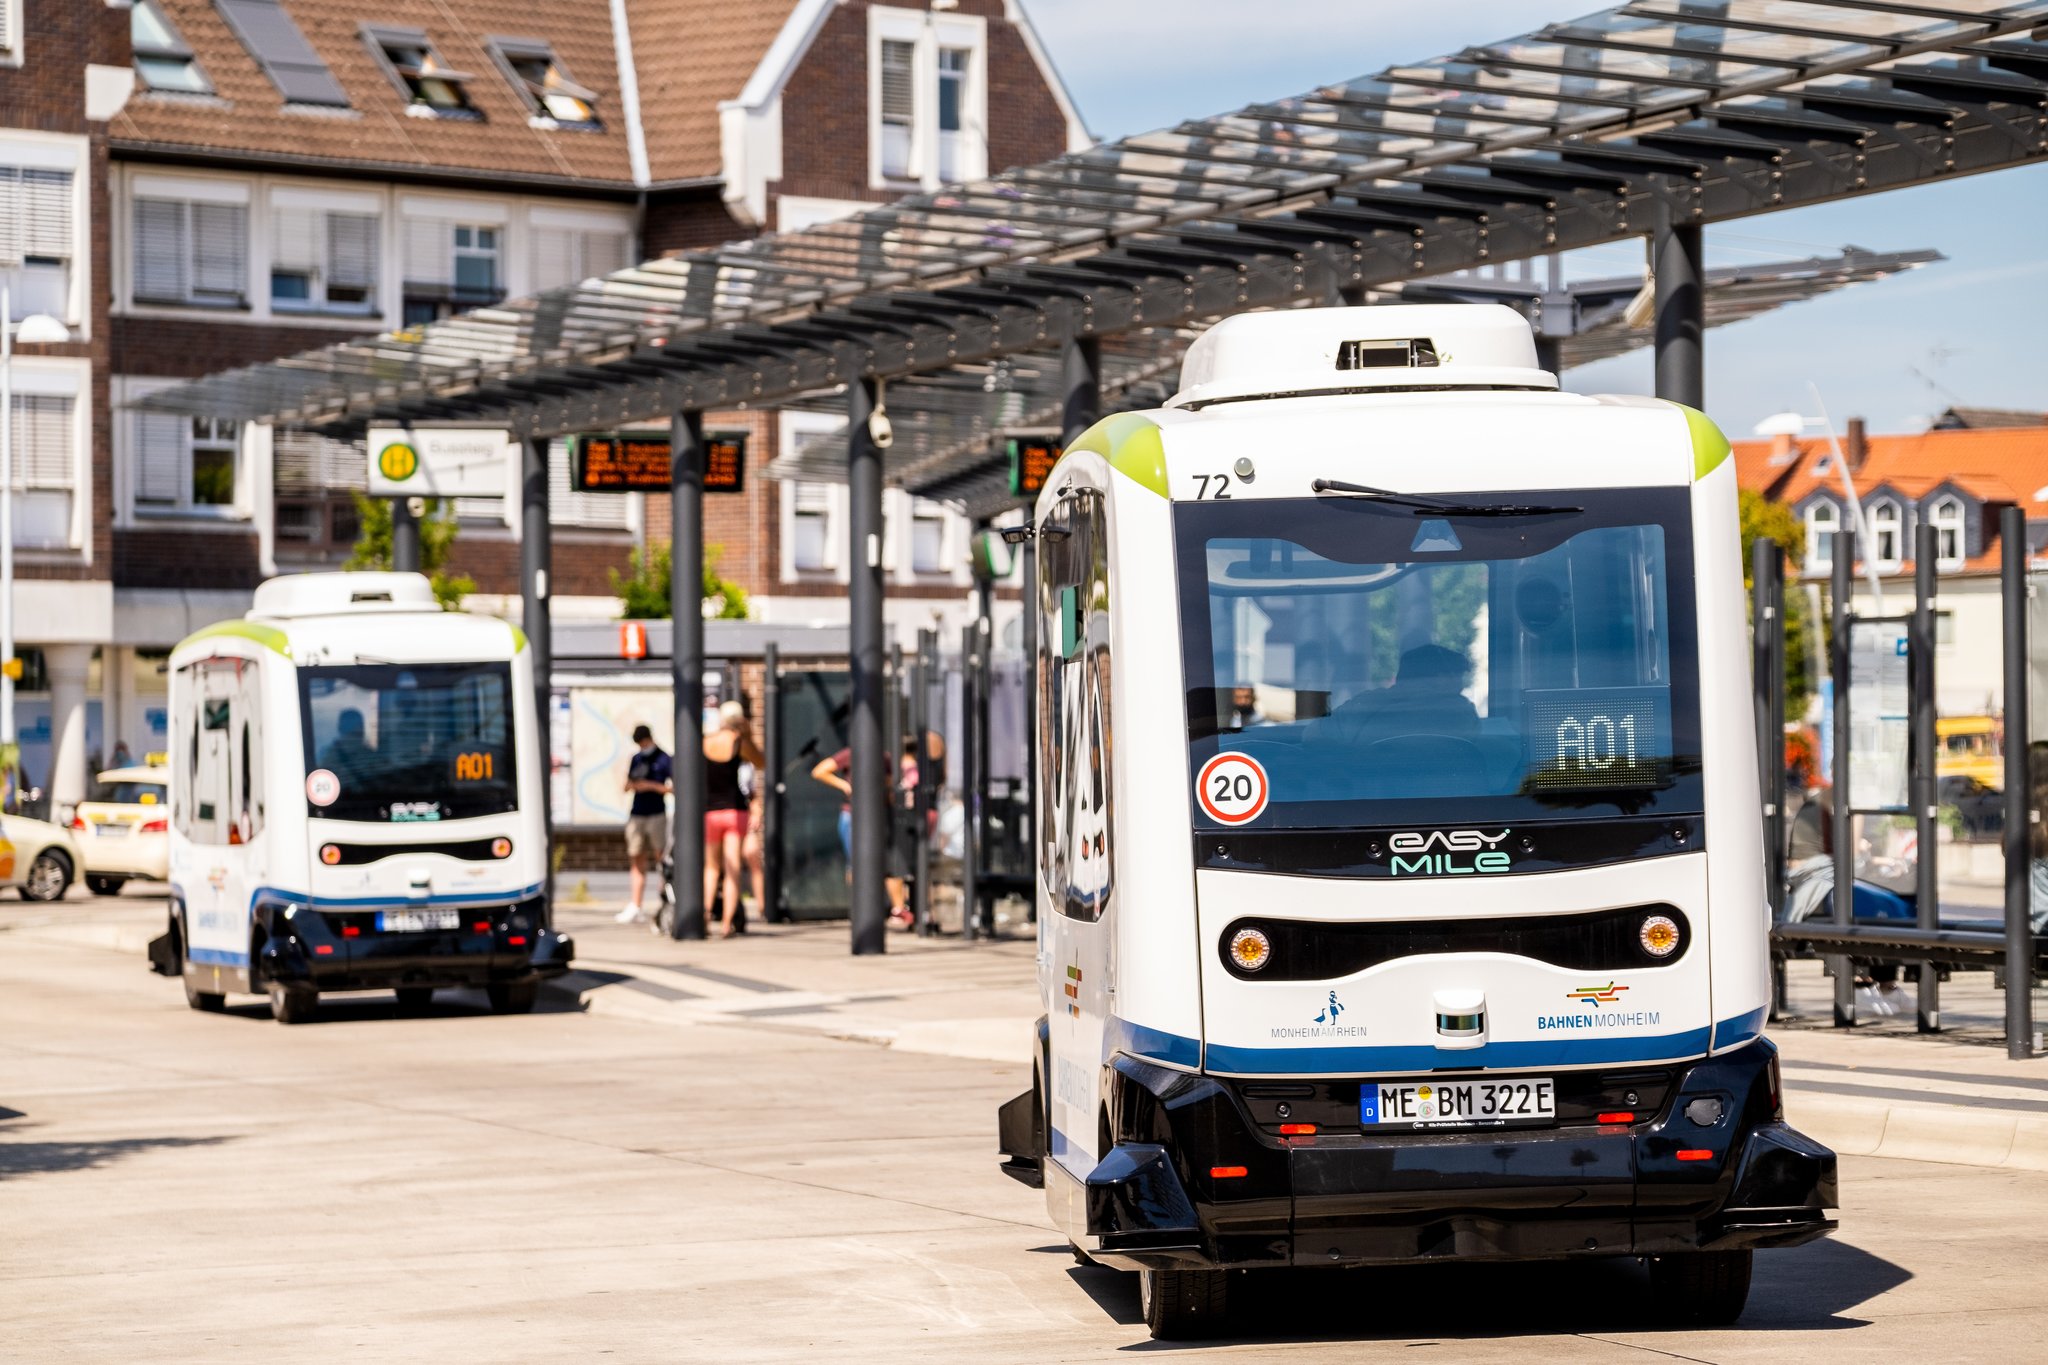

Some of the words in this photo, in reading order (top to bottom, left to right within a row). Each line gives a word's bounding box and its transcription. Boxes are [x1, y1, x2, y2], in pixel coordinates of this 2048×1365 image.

[1192, 474, 1231, 500] 72
[1557, 714, 1636, 770] A01
[456, 752, 493, 780] A01
[1214, 774, 1252, 802] 20
[1366, 1108, 1374, 1117] D
[1381, 1087, 1417, 1118] ME
[1438, 1085, 1473, 1117] BM
